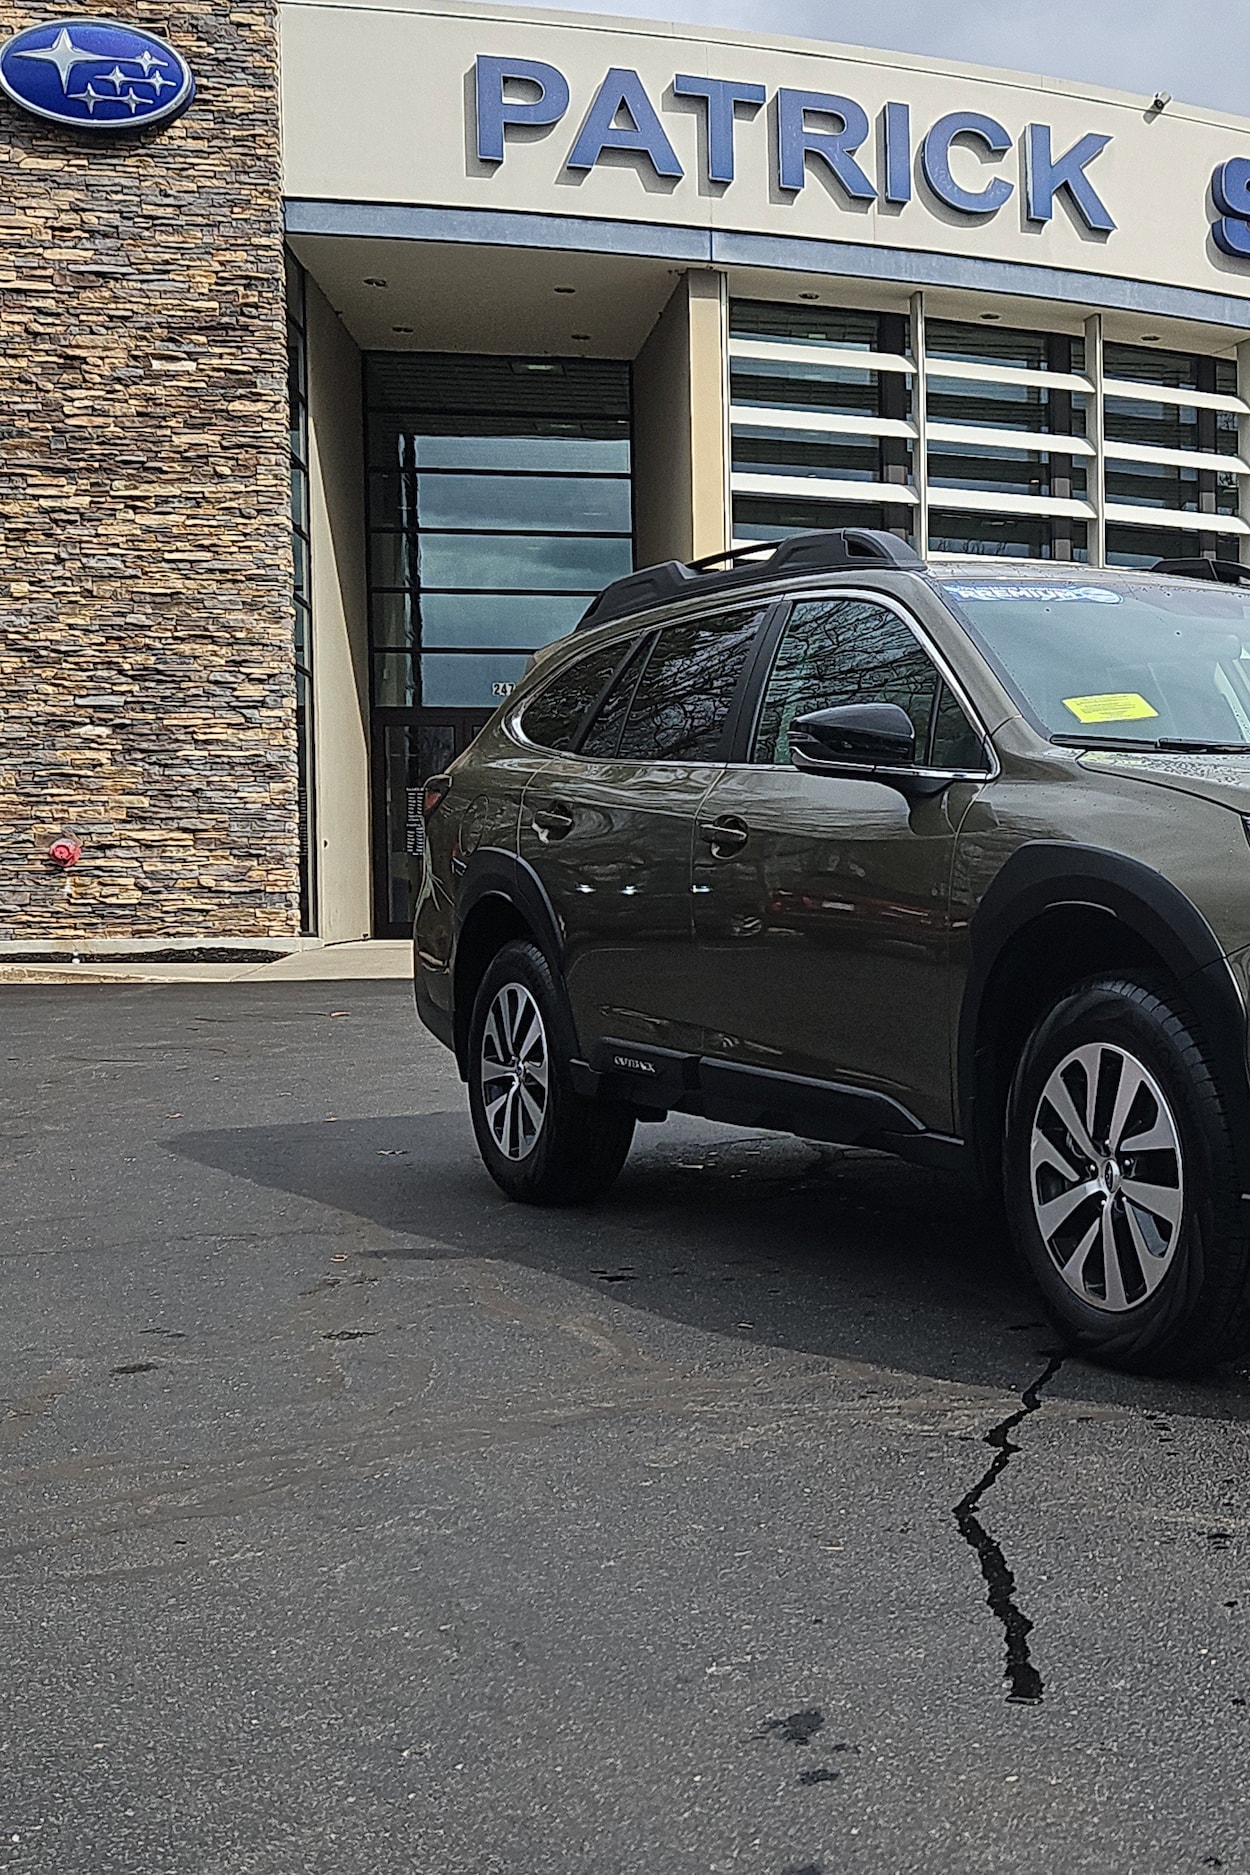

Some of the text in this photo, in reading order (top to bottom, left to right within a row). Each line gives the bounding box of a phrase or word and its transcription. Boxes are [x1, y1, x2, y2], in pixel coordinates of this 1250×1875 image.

[472, 53, 1117, 233] PATRICK
[493, 683, 515, 696] 247
[614, 1055, 656, 1074] OUTBACK
